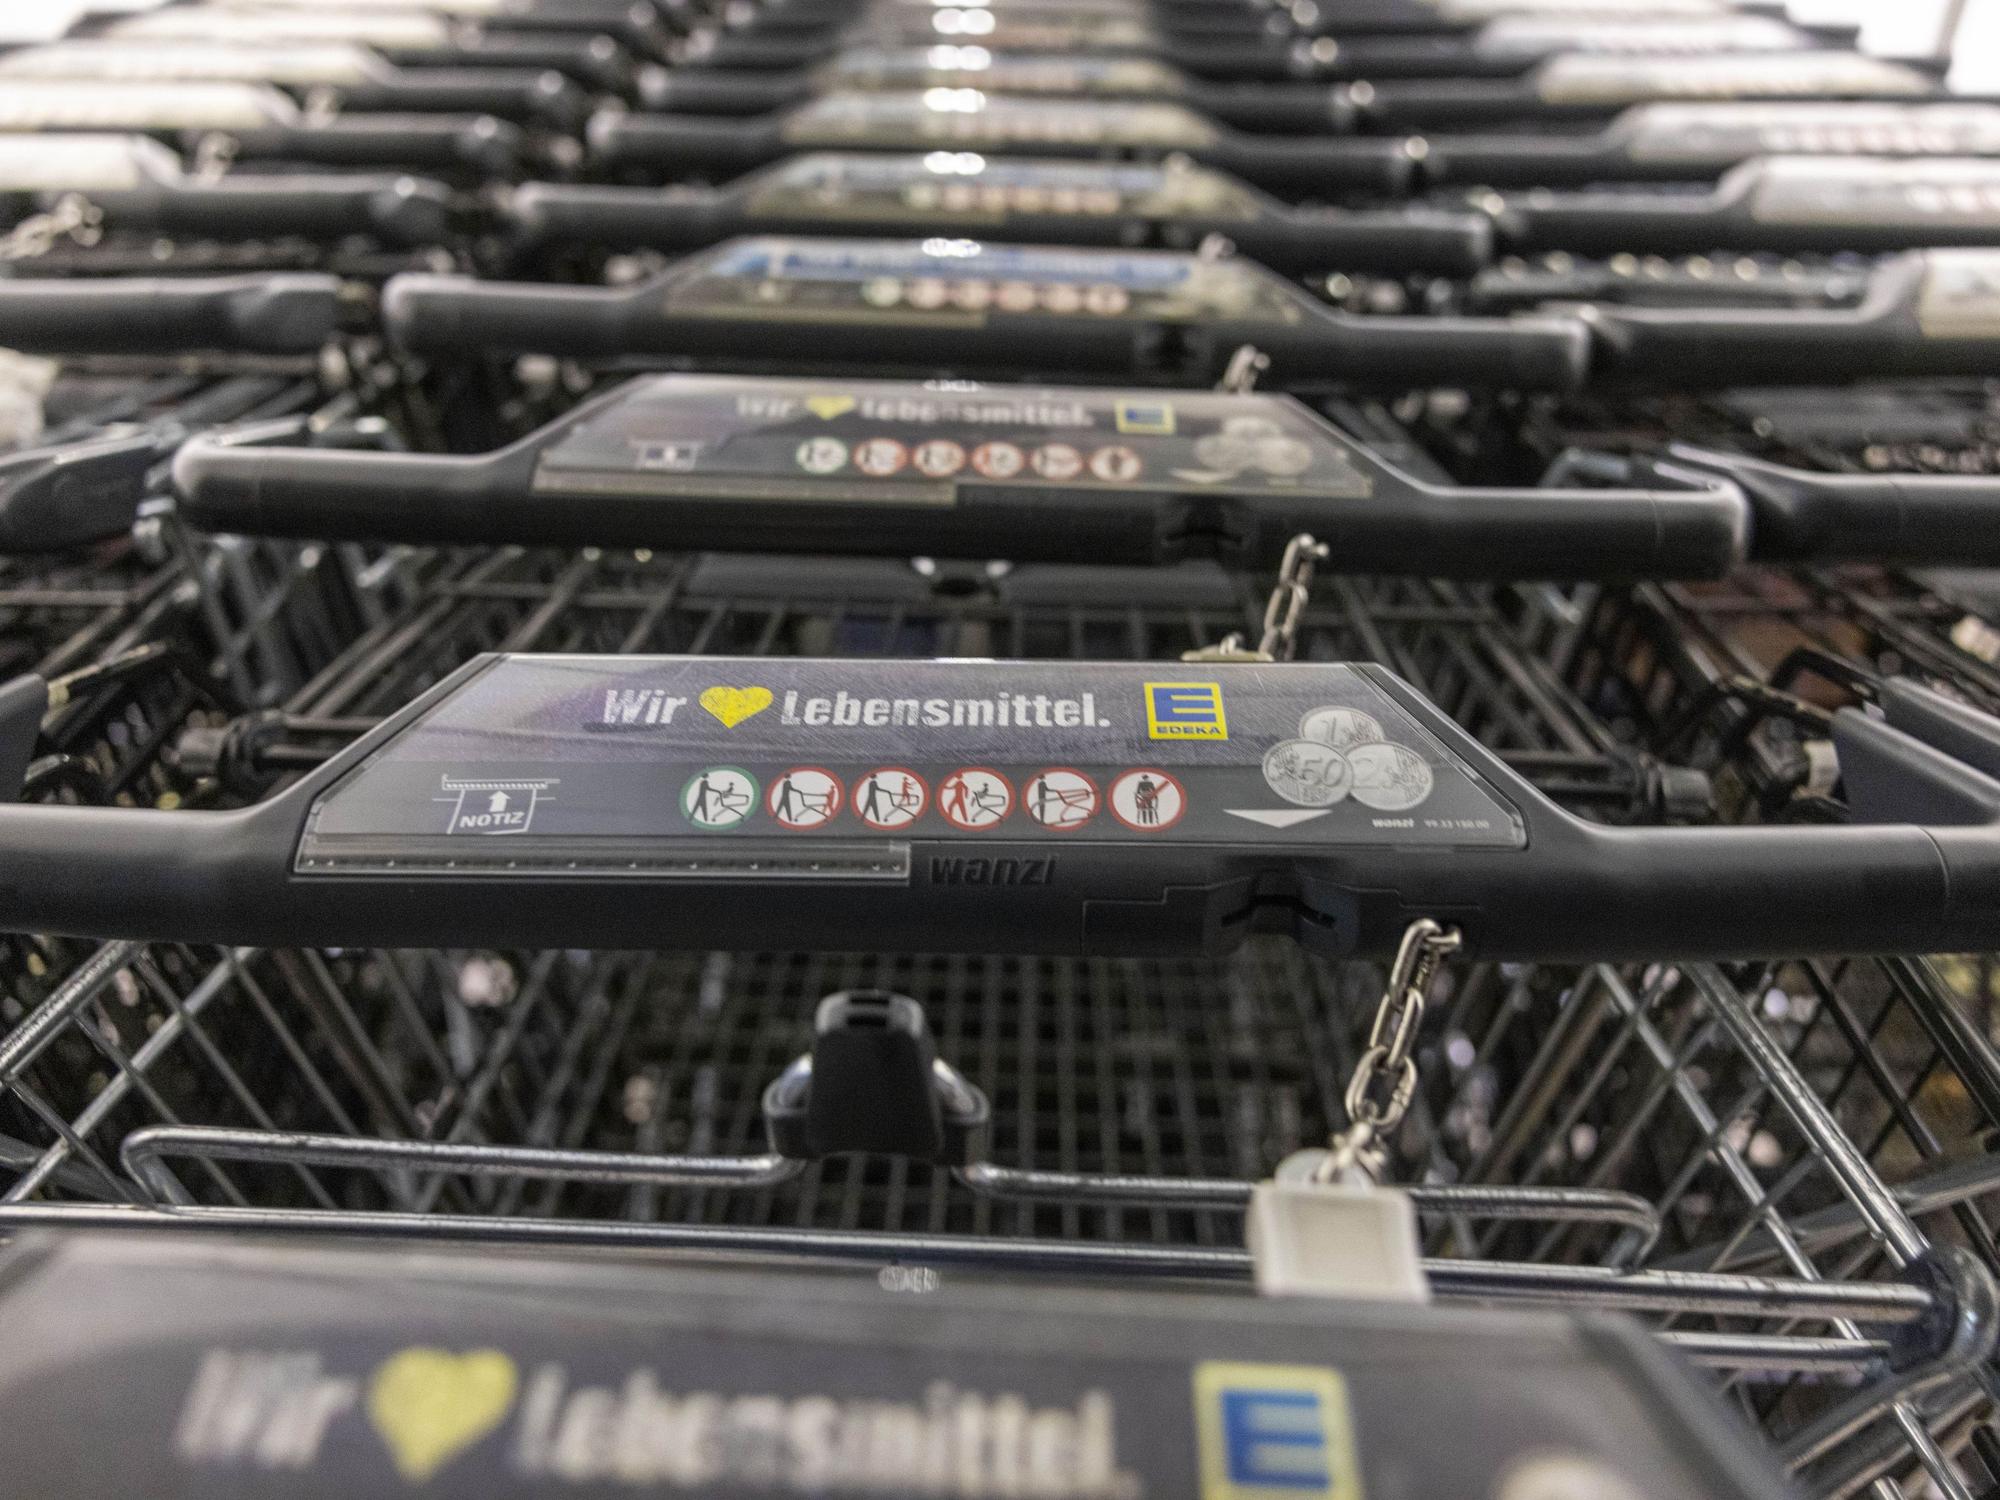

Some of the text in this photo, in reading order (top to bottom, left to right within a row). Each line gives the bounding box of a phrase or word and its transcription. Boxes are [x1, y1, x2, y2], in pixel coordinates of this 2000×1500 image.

[603, 689, 1111, 728] Wir Lebensmittel.
[1156, 725, 1221, 735] EDEKA
[459, 811, 525, 828] NOTIZ
[928, 853, 1058, 885] wanzl
